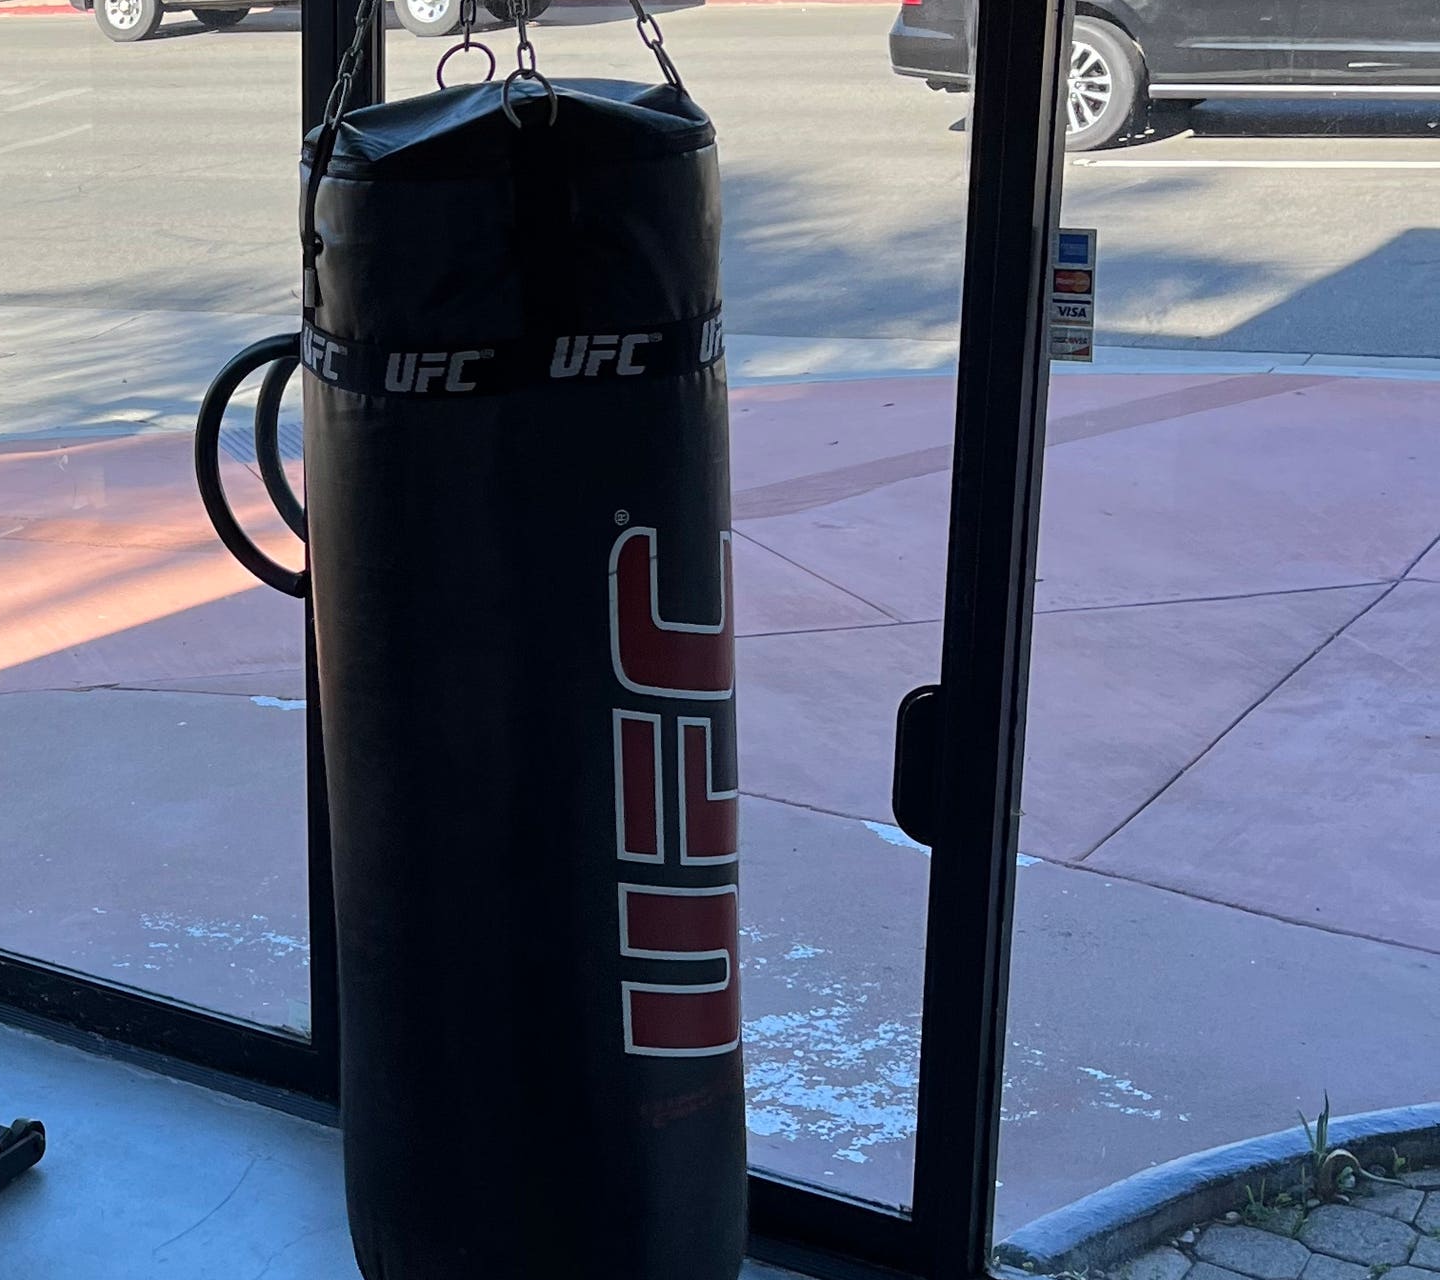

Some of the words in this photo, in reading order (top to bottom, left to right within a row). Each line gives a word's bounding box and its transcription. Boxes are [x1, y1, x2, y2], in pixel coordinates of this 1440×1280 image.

[1057, 306, 1087, 318] VISA
[385, 351, 482, 392] UFC
[550, 334, 652, 378] UFC
[609, 526, 739, 1058] UFC
